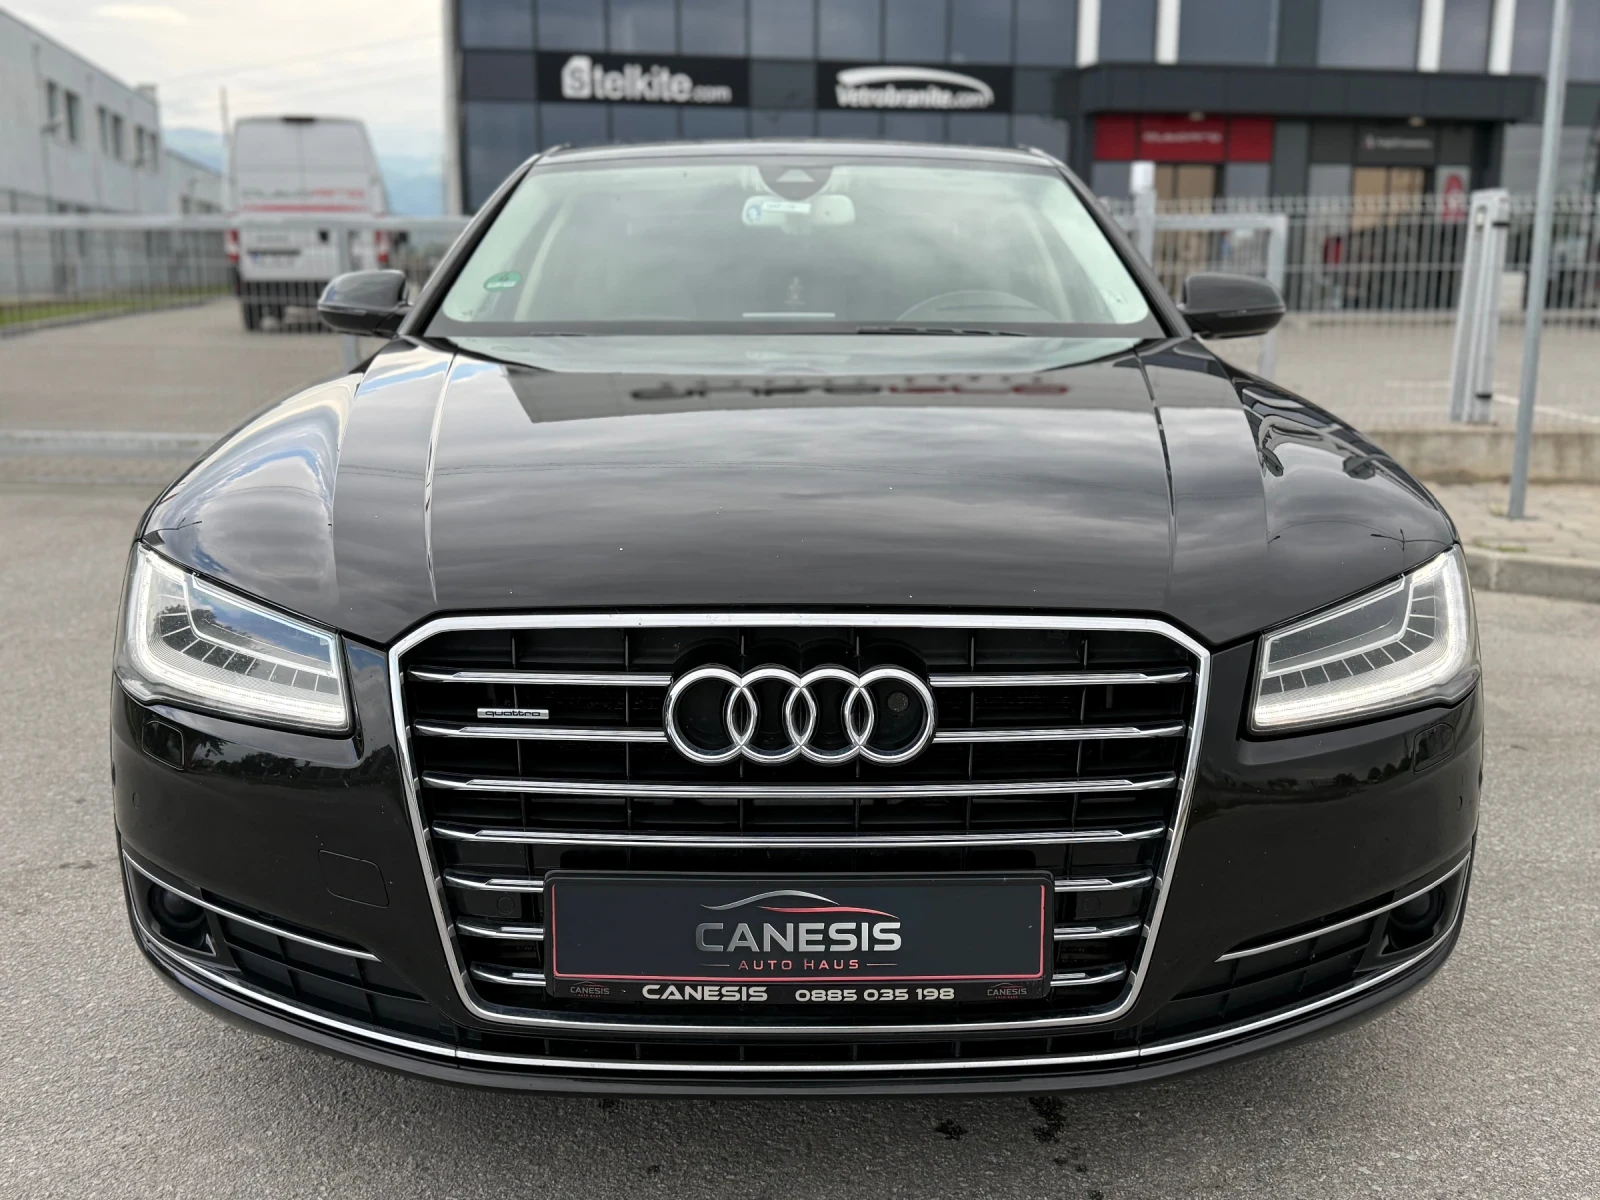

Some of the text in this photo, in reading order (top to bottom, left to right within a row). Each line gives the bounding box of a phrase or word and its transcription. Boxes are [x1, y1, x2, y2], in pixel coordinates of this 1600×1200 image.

[485, 710, 541, 718] quattro
[695, 921, 902, 952] CANESIS
[738, 959, 860, 970] AUTO HAUS
[570, 986, 610, 995] CANESIS
[642, 984, 768, 1002] CANESIS
[795, 987, 955, 1002] 0885 035 198
[987, 987, 1027, 996] CANESIS
